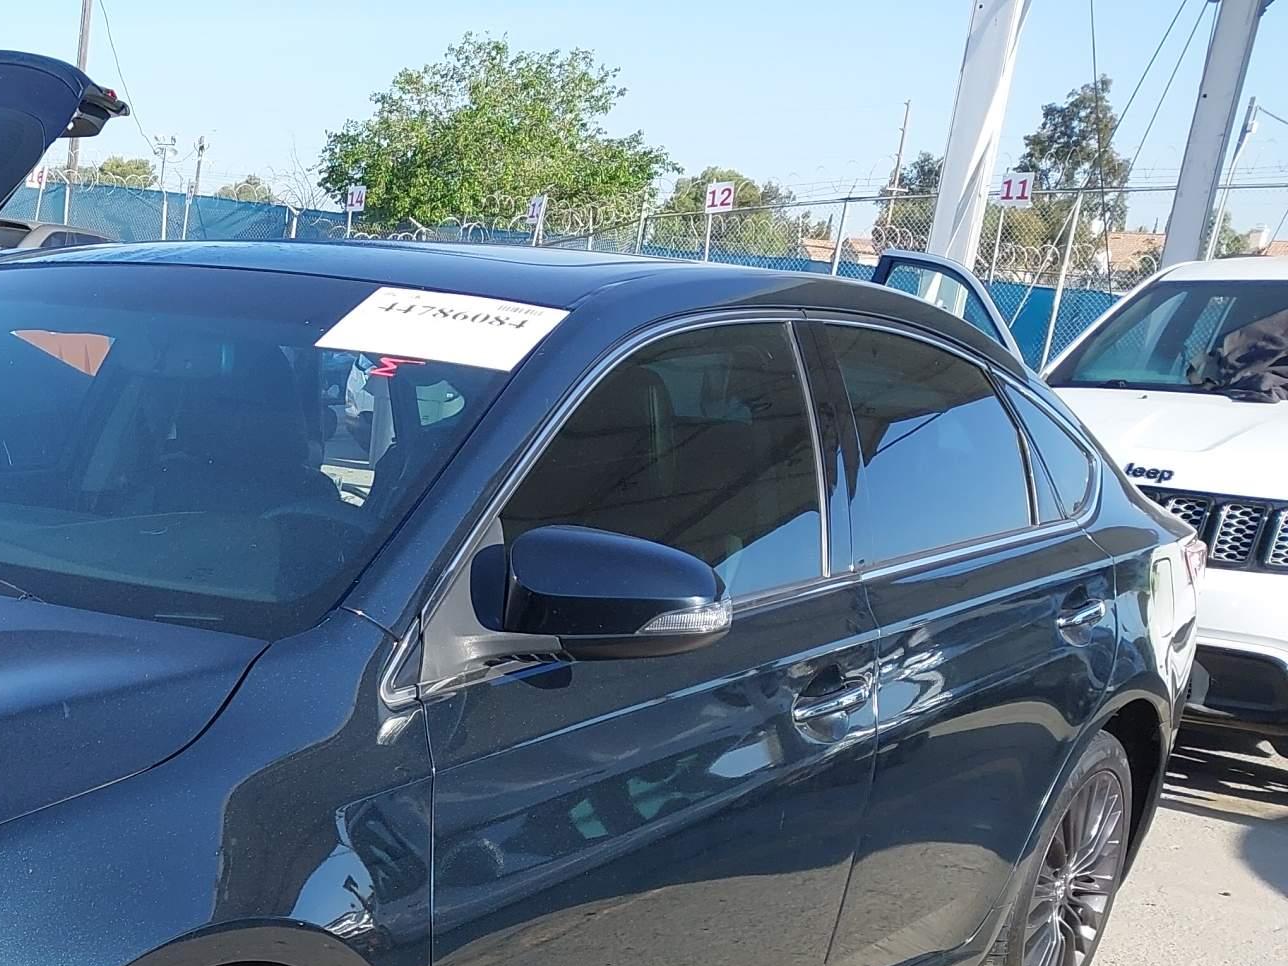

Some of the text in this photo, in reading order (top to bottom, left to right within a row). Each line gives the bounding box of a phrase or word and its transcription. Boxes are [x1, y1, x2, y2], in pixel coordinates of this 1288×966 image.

[348, 191, 364, 208] 14
[707, 187, 732, 208] 12
[1001, 179, 1029, 200] 11
[378, 301, 529, 329] 44786084
